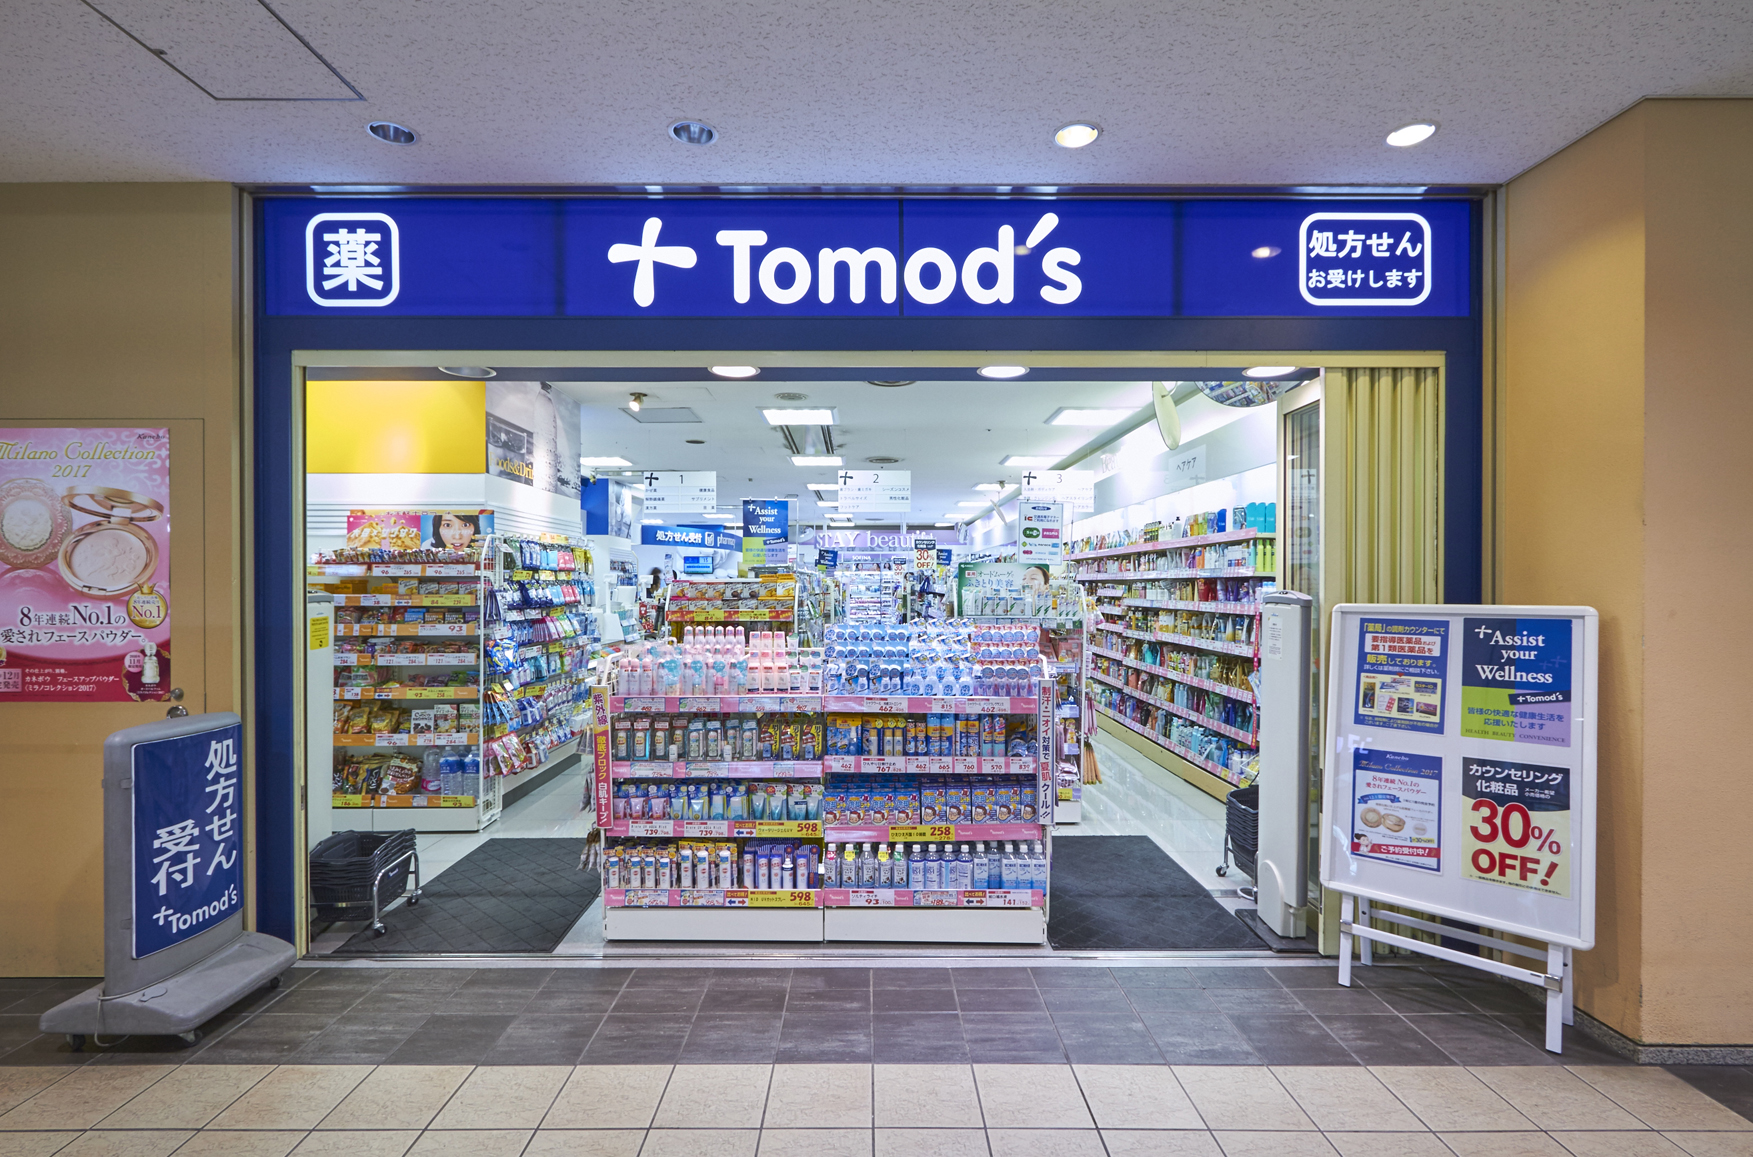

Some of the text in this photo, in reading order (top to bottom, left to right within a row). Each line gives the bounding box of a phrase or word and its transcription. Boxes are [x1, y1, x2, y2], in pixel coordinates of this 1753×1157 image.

[1309, 230, 1422, 258] 処方せん
[322, 228, 384, 291] 薬
[716, 212, 1082, 305] Tomod's
[1308, 269, 1422, 288] お受けします
[64, 441, 155, 459] Collection
[52, 465, 92, 477] 2017
[1176, 457, 1196, 472] ヘアケア
[680, 475, 683, 484] 1
[873, 474, 879, 483] 2
[1057, 474, 1062, 483] 3
[754, 507, 778, 515] Assist
[656, 530, 702, 543] 処方せん受付
[748, 525, 781, 534] Wellness
[816, 531, 860, 548] STAY
[917, 549, 934, 560] 30%
[19, 605, 126, 626] 8年連続No.1の
[131, 605, 161, 619] No.1
[0, 628, 146, 644] 愛されフェースパウダー。
[1489, 630, 1545, 647] Assist
[1367, 654, 1436, 667] 販売しております。
[1501, 649, 1537, 662] your
[1475, 664, 1553, 683] Wellness
[1526, 692, 1563, 702] Tomod's
[593, 694, 608, 725] 紫外線
[1467, 707, 1564, 722] 皆様の快適な健康生活を
[1484, 718, 1545, 731] 応援いたします
[1519, 734, 1565, 743] CONVENIENCE
[596, 735, 607, 780] 徹底ブロック
[1469, 764, 1563, 785] カウンセリング
[1366, 782, 1427, 795] 愛されフェースパウダー
[1476, 779, 1518, 796] 化粧品
[1525, 787, 1555, 795] メーカー希望
[205, 739, 237, 876] 処方せん
[797, 823, 818, 832] 598
[930, 827, 951, 836] 258
[1470, 798, 1561, 855] 30%
[151, 818, 201, 896] 受付
[1471, 848, 1559, 886] OFF!
[790, 892, 811, 901] 598
[168, 883, 238, 933] Tomod's
